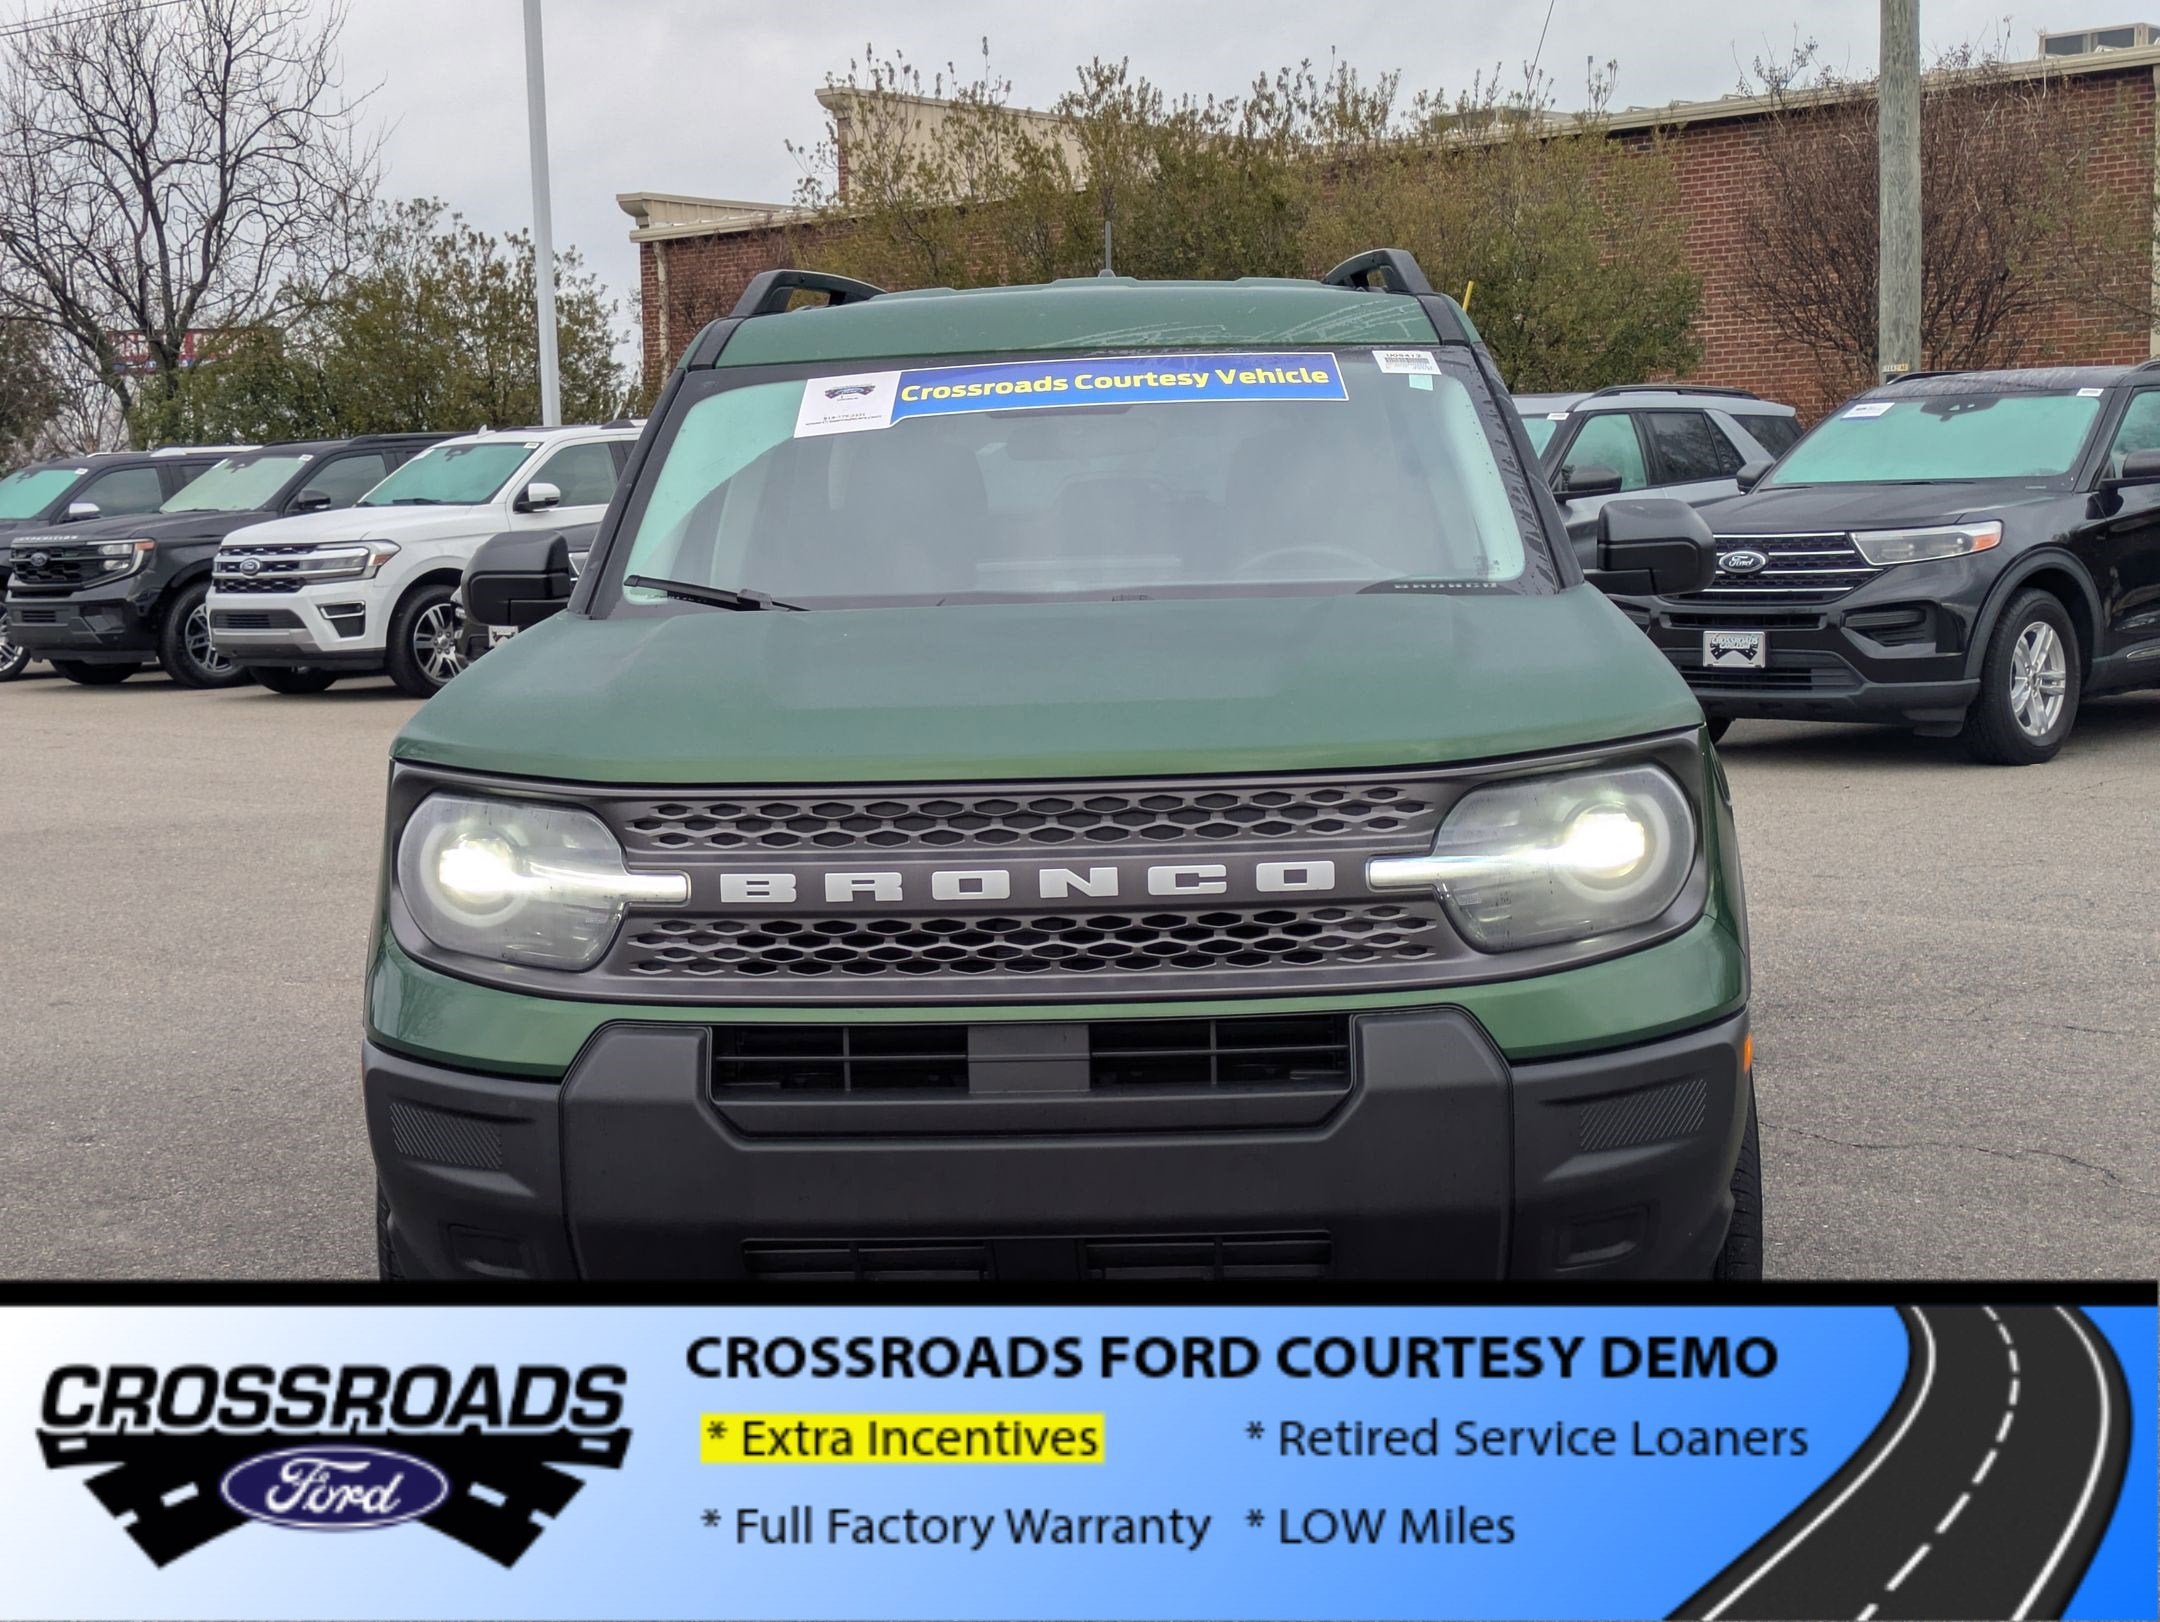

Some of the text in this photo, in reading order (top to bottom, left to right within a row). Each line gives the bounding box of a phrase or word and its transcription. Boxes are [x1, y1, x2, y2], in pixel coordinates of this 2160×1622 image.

[901, 367, 1330, 402] Crossroads Courtesy Vehicle
[720, 861, 1336, 902] BRONCO
